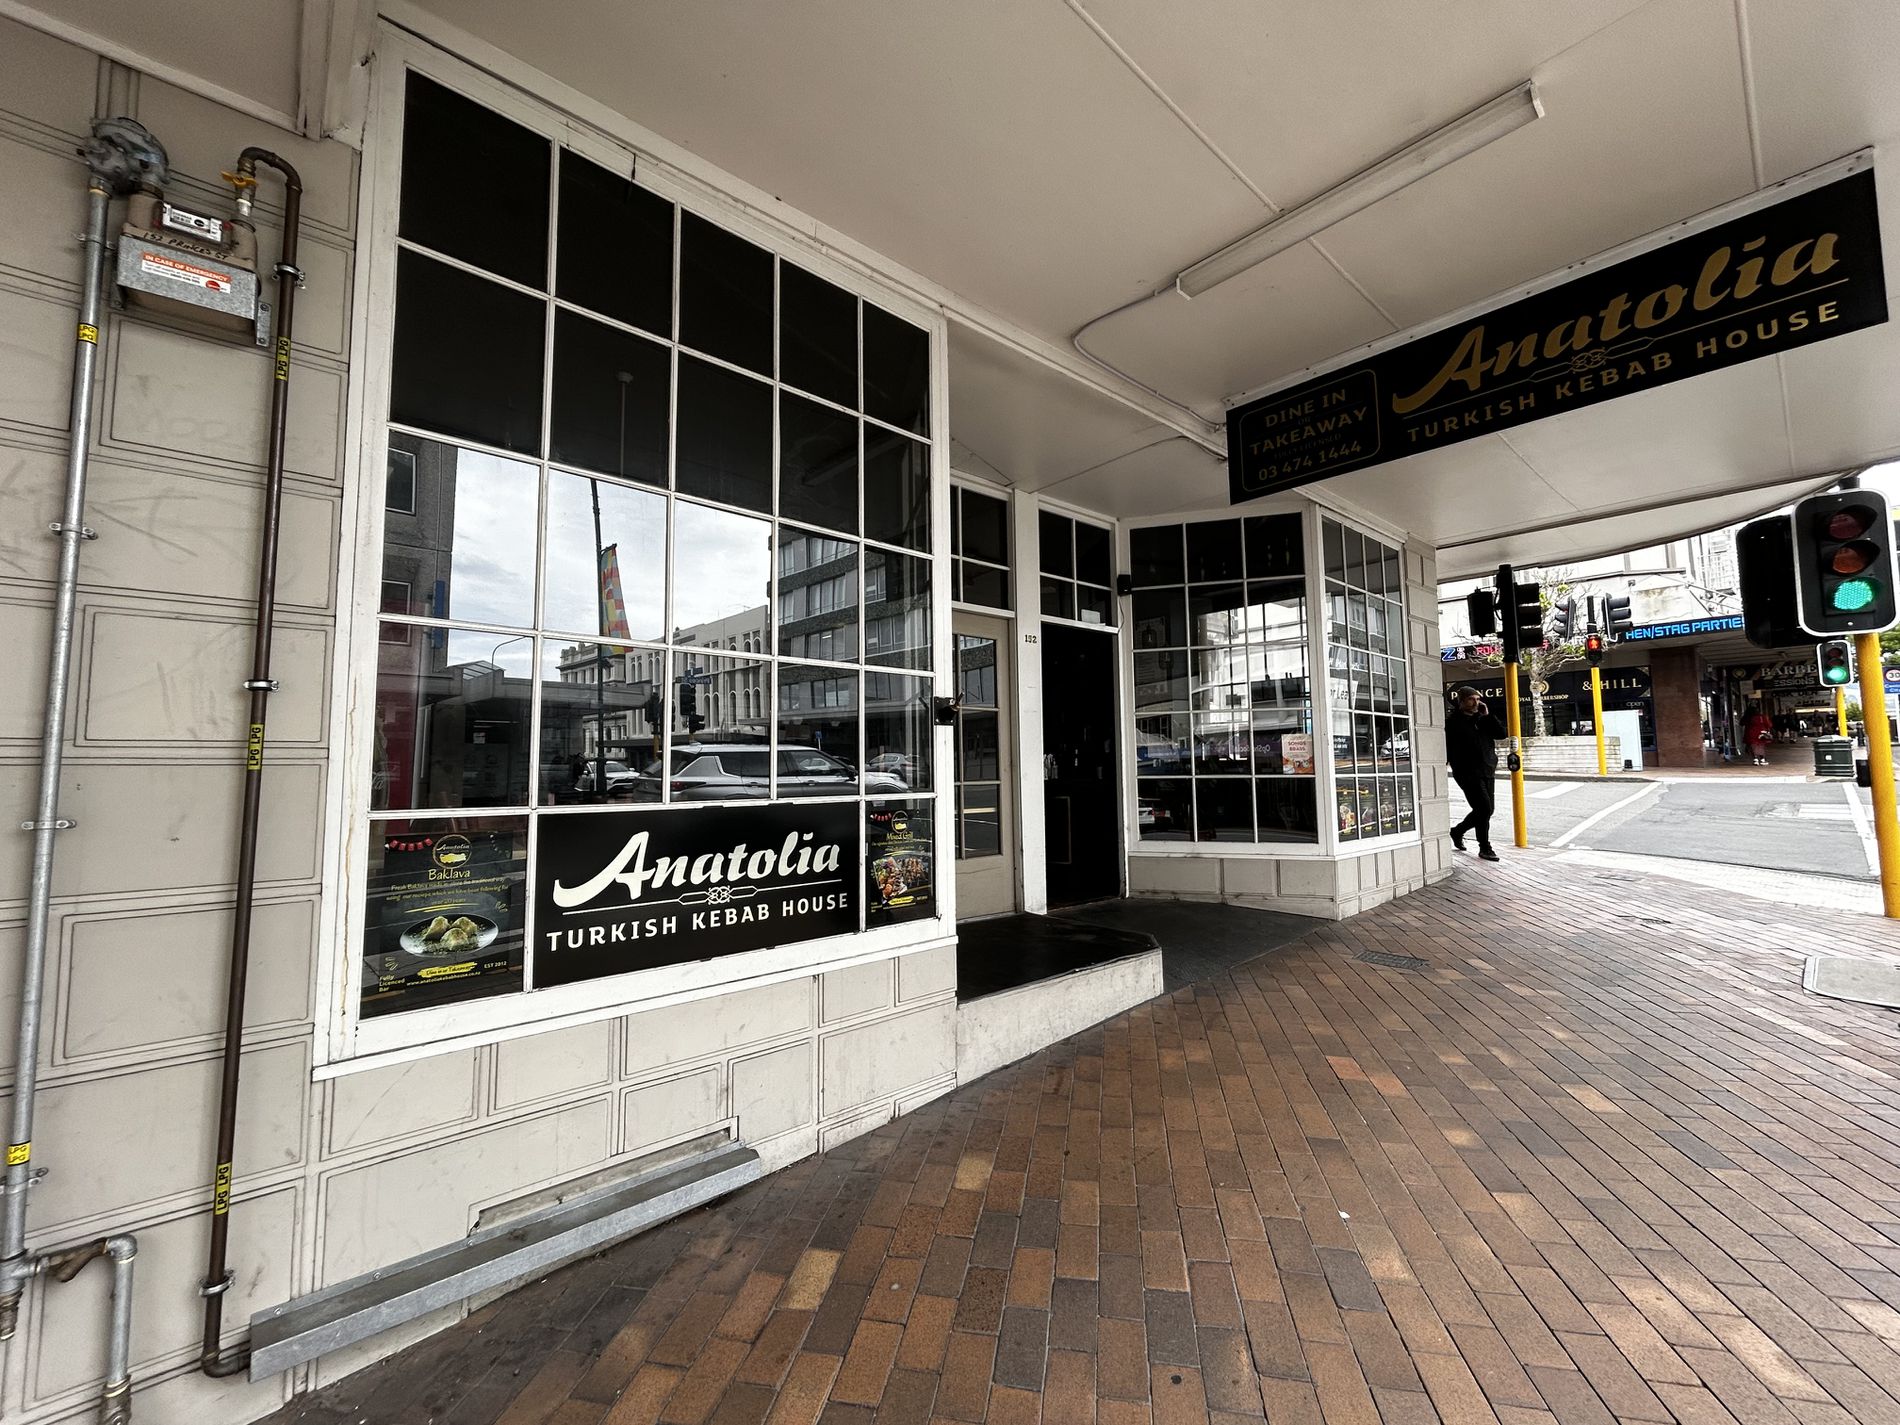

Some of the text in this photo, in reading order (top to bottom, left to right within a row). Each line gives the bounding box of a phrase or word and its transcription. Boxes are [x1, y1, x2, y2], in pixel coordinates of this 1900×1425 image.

[155, 257, 174, 267] CASE
[174, 262, 185, 270] OF
[185, 265, 229, 282] EMERGENCY
[1392, 233, 1840, 414] Anatolia
[278, 340, 289, 378] LPG LPG
[1408, 300, 1841, 442] TURKISH KEBAB HOUSE
[1265, 389, 1346, 428] DINE IN
[1249, 406, 1368, 456] TAKEAWAY
[1258, 440, 1362, 481] 03 474 1444
[1025, 634, 1037, 643] 152
[1626, 623, 1690, 640] HEN/STAG
[250, 727, 261, 766] LPG LPG
[428, 868, 471, 881] Baklava
[552, 830, 840, 907] Anatolia
[546, 891, 848, 952] TURKISH KEBAB HOUSE
[217, 1166, 229, 1211] LPG LPG
